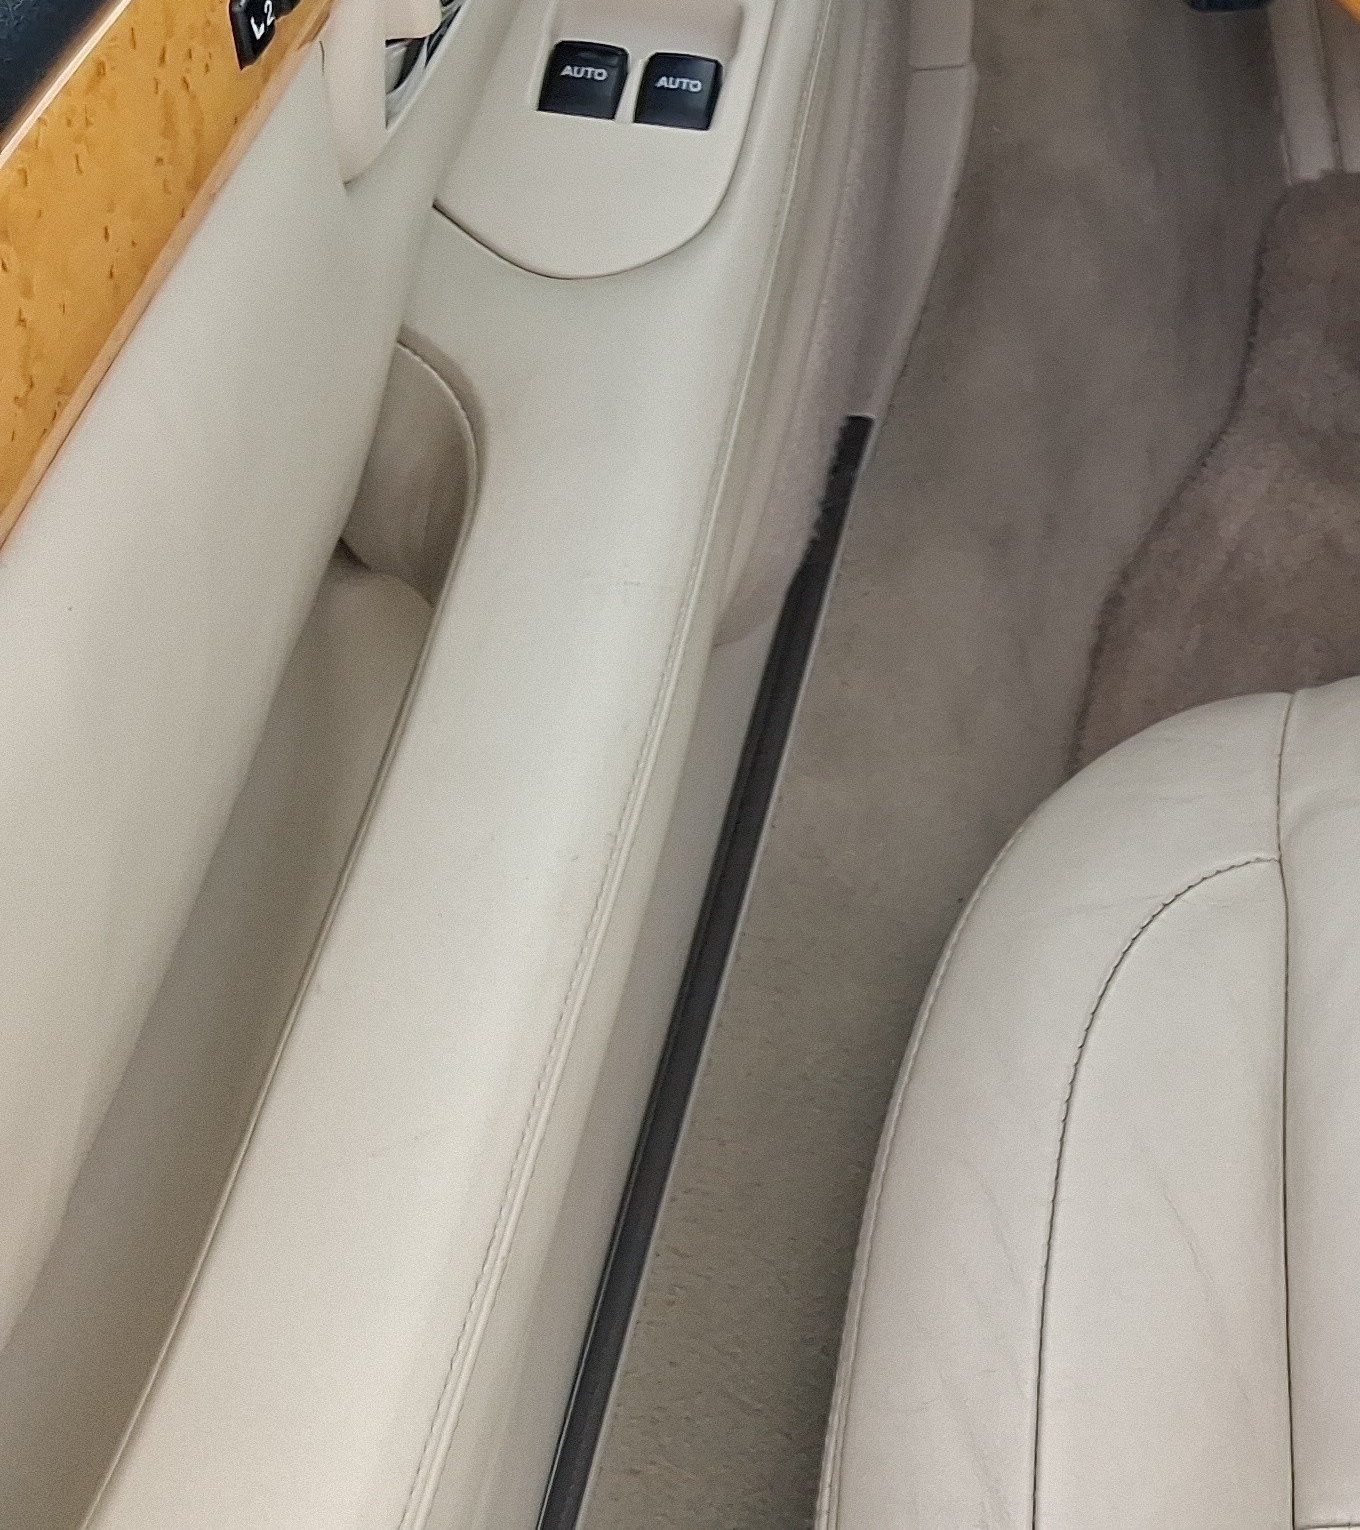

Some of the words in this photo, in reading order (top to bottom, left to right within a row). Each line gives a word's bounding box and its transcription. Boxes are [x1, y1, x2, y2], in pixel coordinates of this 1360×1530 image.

[263, 0, 275, 25] 2
[561, 65, 608, 80] AUTO
[655, 75, 702, 92] AUTO
